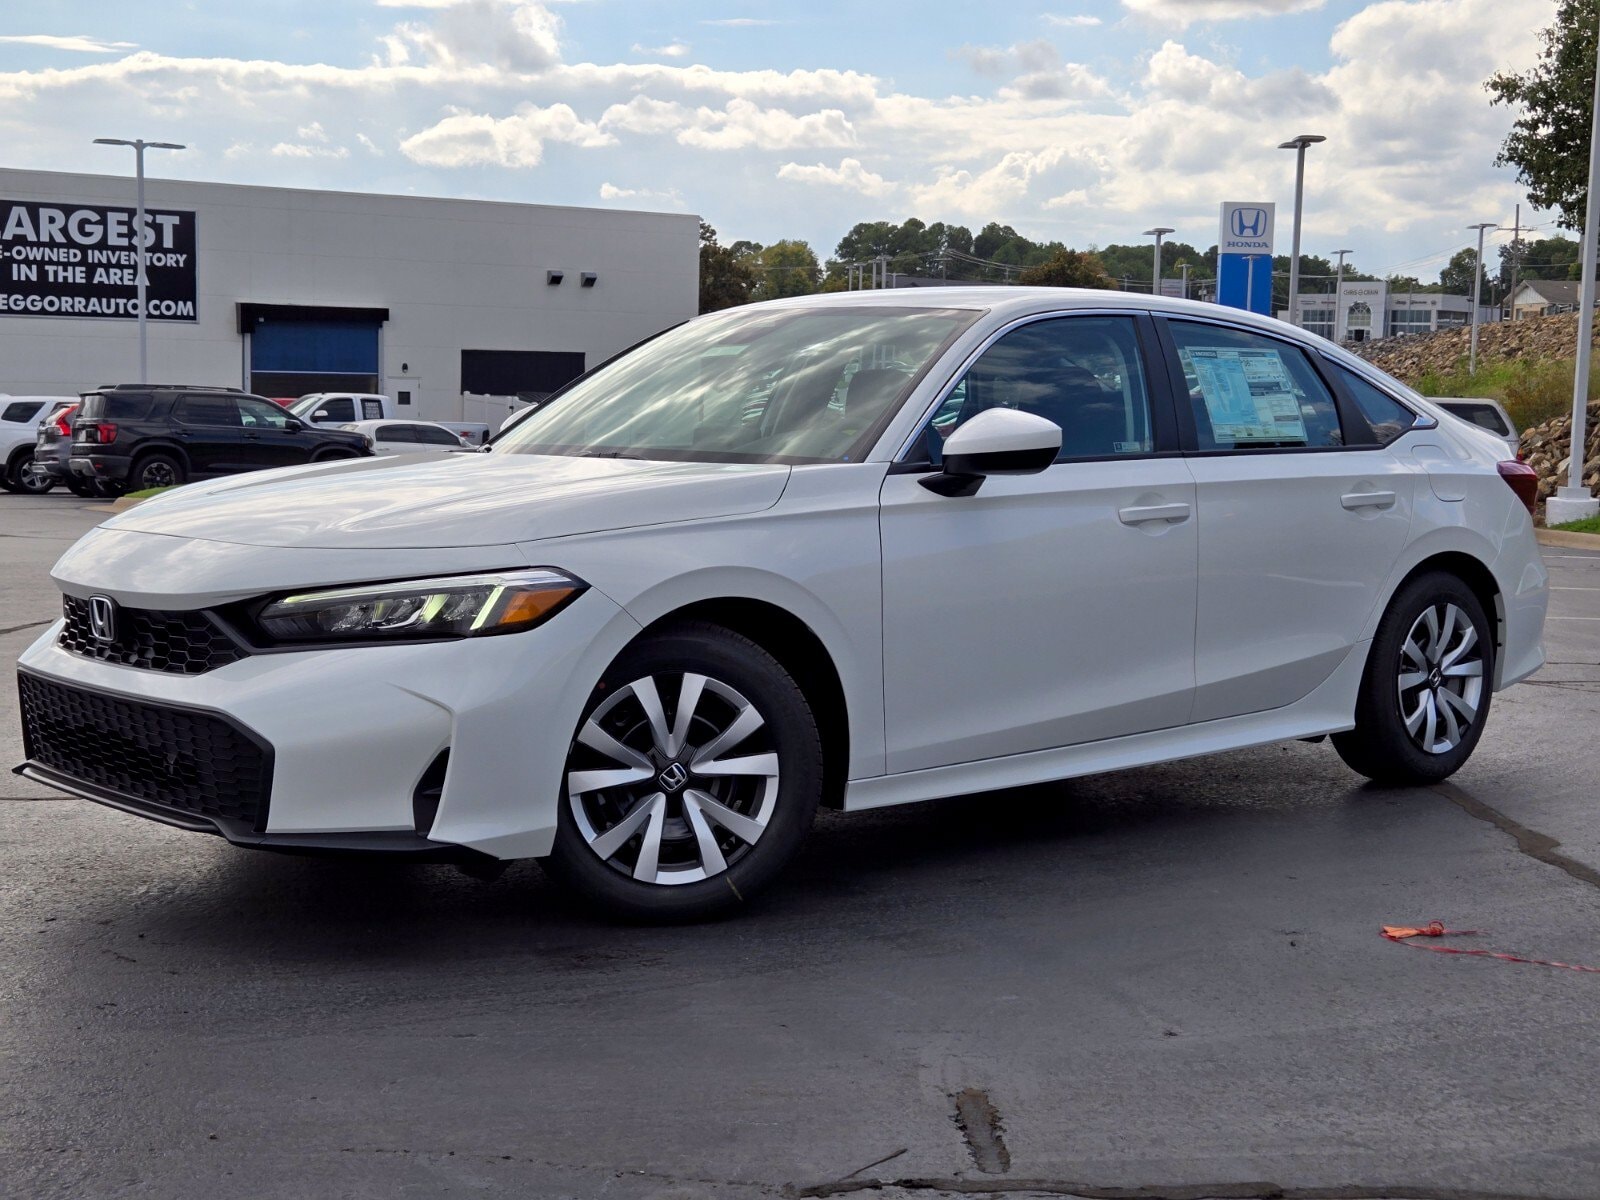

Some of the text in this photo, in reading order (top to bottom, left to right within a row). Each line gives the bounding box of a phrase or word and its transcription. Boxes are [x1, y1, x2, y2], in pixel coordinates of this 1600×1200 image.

[0, 206, 180, 249] ARGEST
[0, 245, 187, 267] -OWNED INVENTORY
[12, 264, 37, 281] IN
[45, 265, 86, 283] THE
